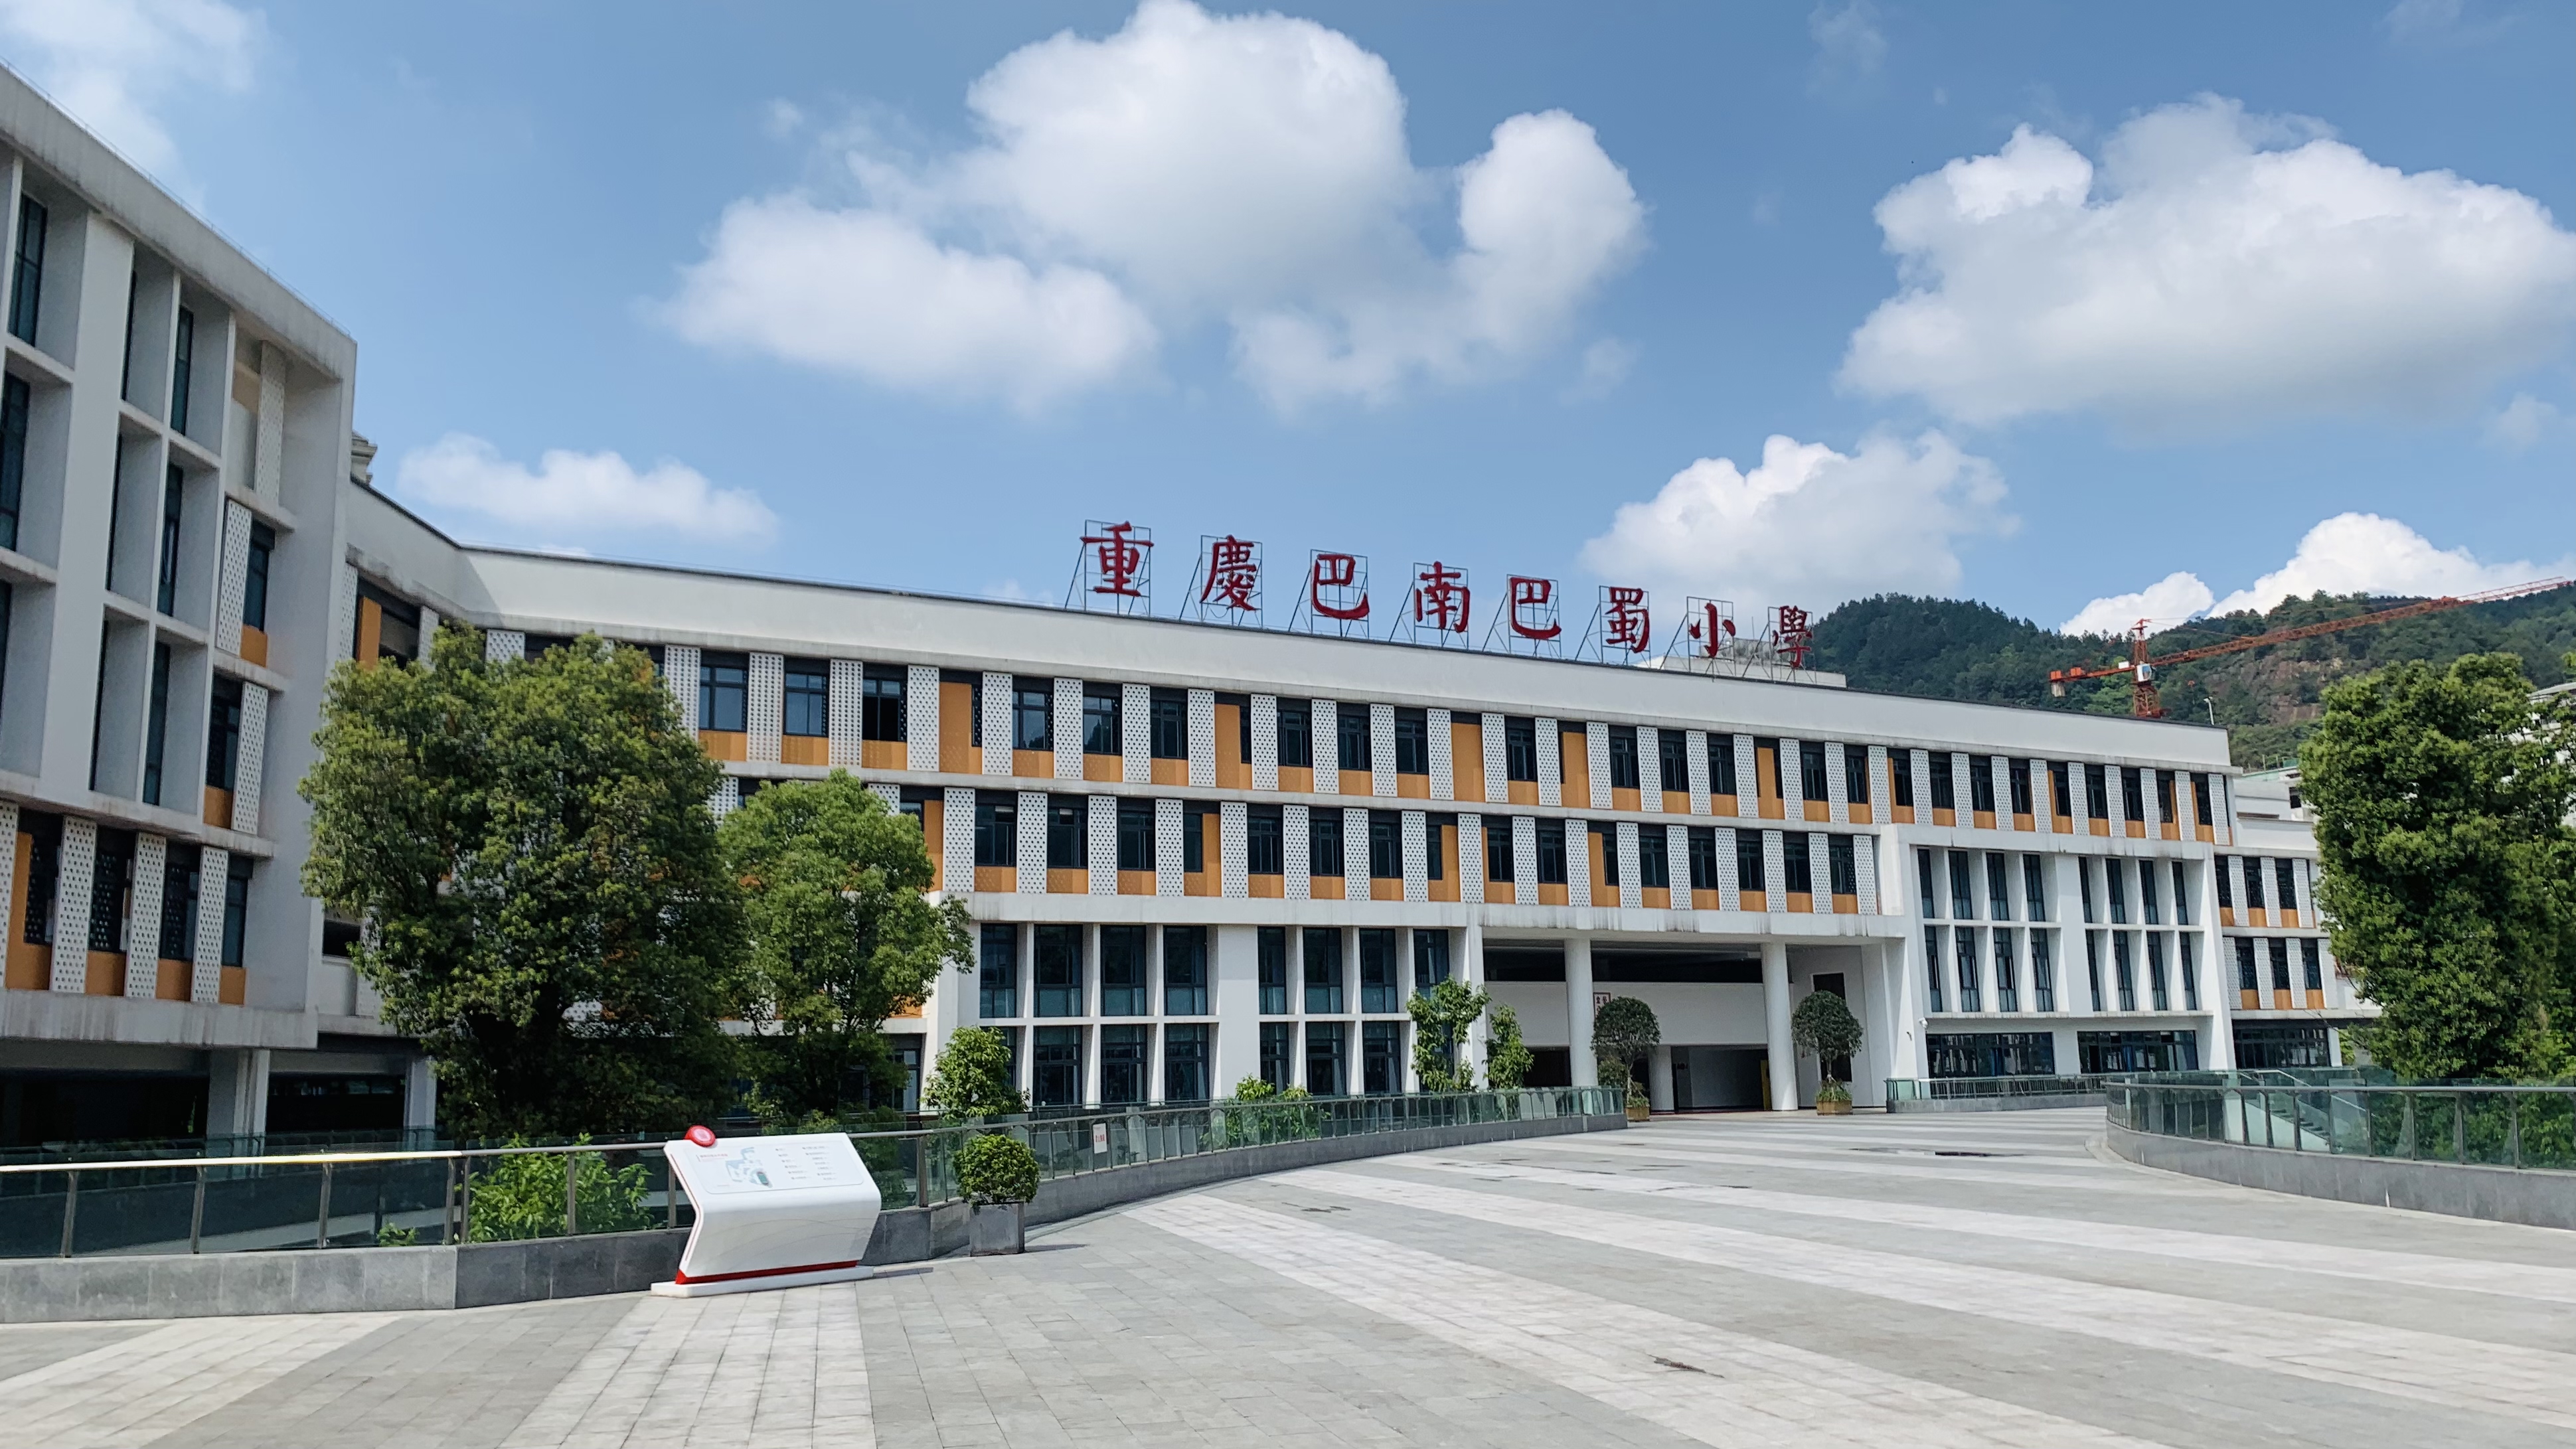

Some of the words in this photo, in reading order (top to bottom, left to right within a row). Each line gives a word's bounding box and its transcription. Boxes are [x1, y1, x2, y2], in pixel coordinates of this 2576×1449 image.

[1080, 520, 1812, 669] 重慶巴南巴蜀小學
